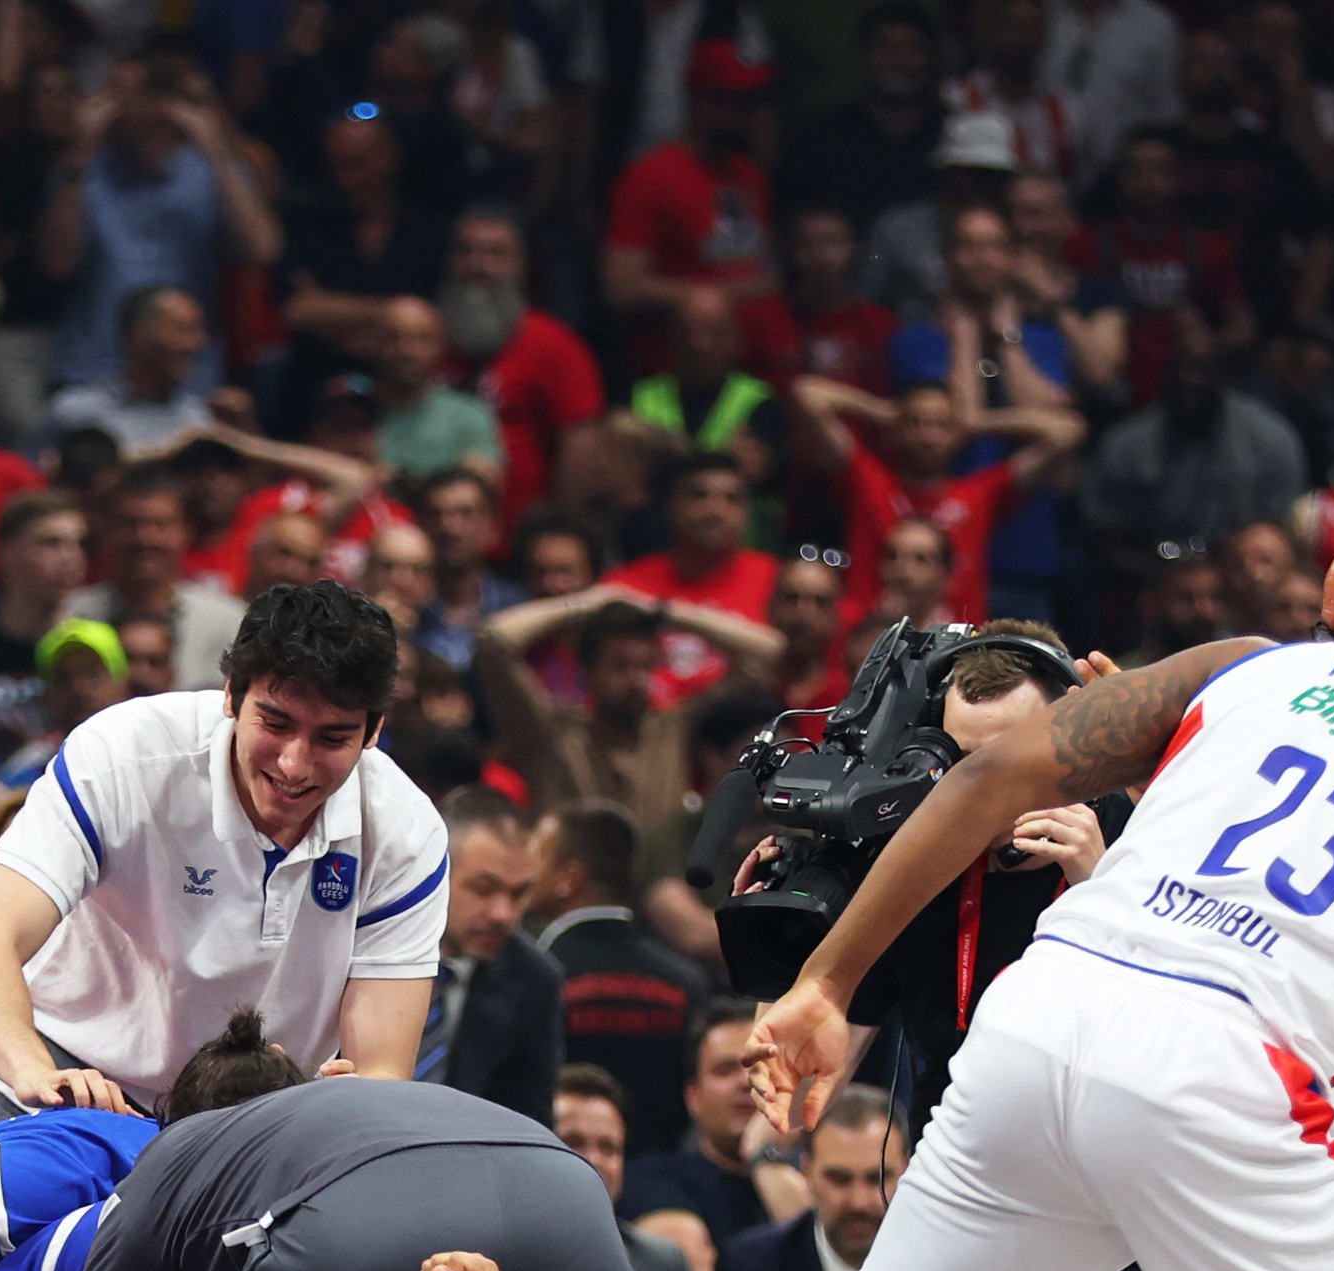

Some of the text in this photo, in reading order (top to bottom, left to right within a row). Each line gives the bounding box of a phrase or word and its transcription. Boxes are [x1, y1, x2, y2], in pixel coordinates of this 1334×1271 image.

[183, 883, 215, 897] bilcee
[321, 889, 345, 900] EFES
[1142, 873, 1283, 960] ISTANBUL
